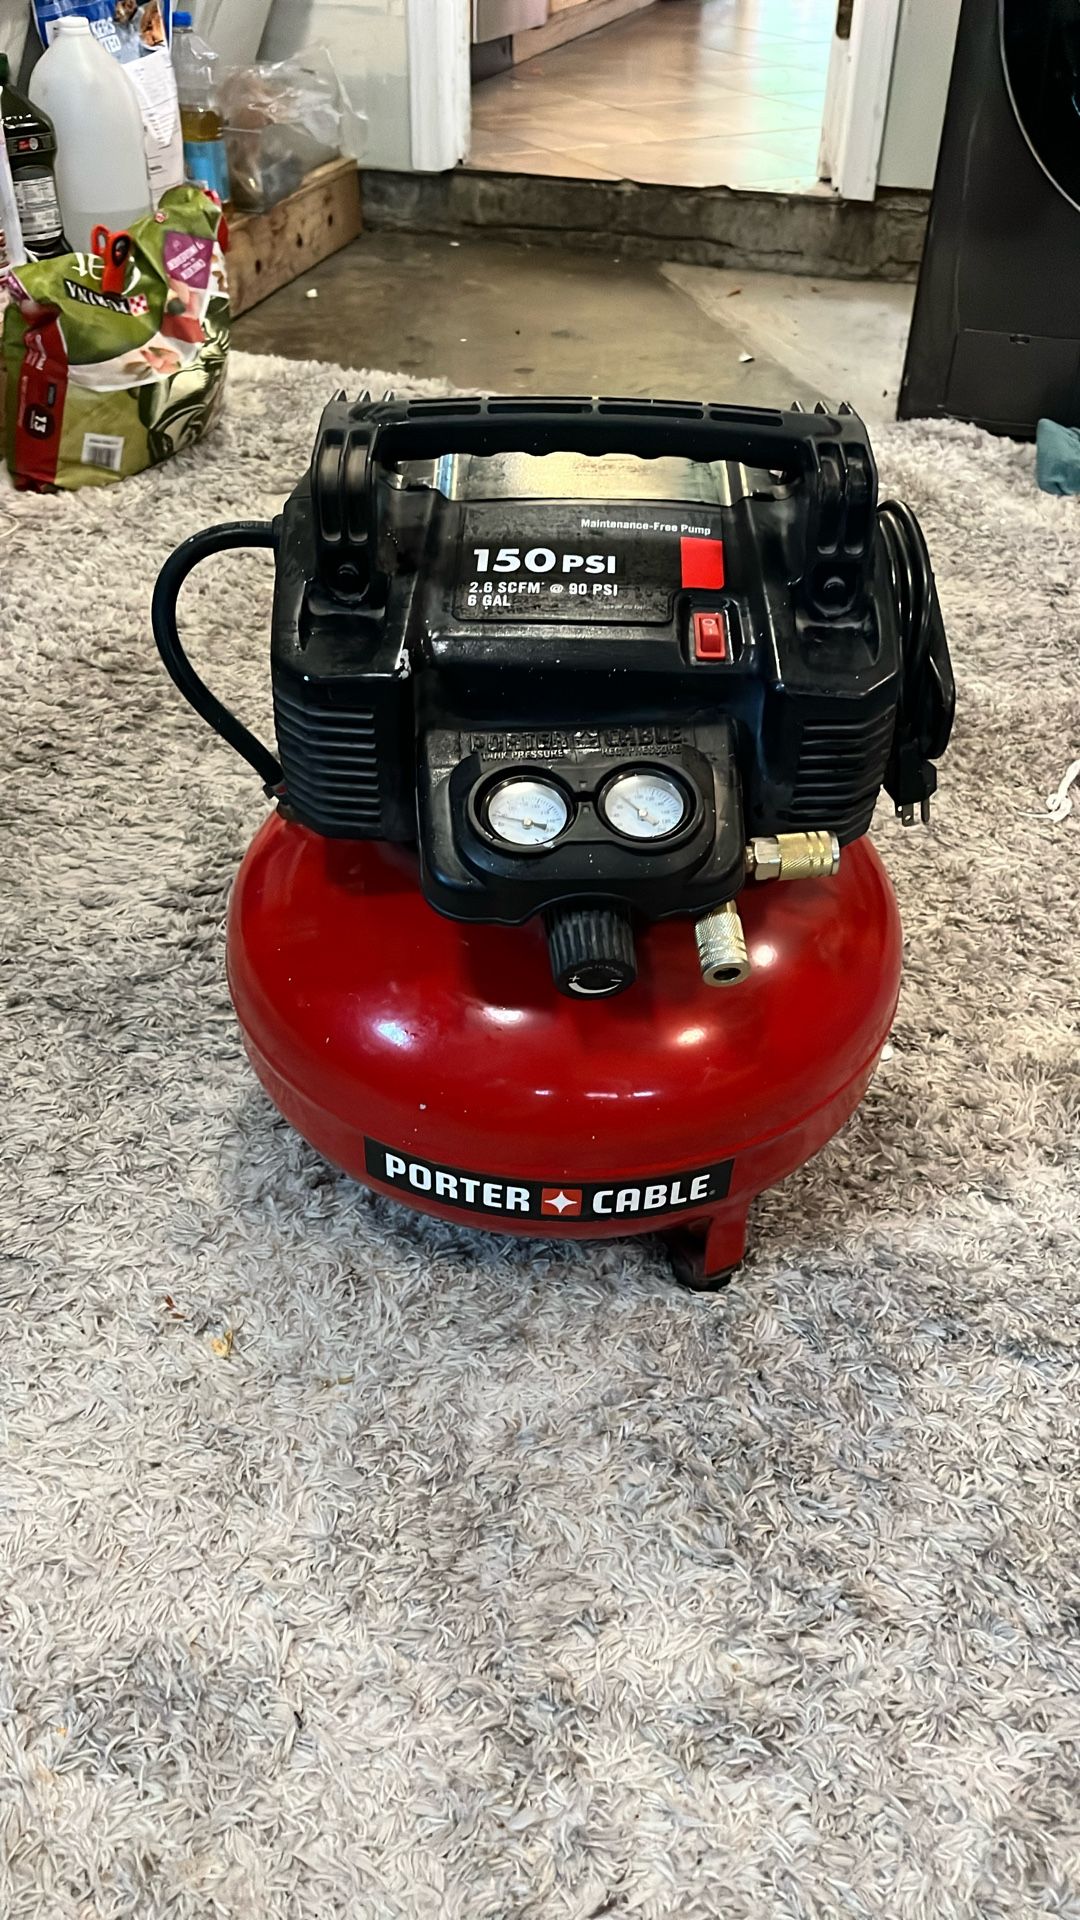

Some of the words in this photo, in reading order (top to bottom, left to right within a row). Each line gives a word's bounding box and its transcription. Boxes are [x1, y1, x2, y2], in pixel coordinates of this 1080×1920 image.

[581, 518, 678, 533] Maintenance-Free
[681, 524, 711, 536] Pump
[474, 547, 556, 573] 150
[562, 554, 616, 574] PSI
[469, 581, 493, 594] 2.6
[550, 583, 564, 594] @
[569, 583, 587, 595] 90
[593, 584, 618, 597] PSI
[467, 595, 477, 606] 6
[482, 595, 511, 607] GAL
[512, 749, 564, 759] PRESSURE
[385, 1153, 530, 1211] PORTER
[593, 1174, 710, 1213] CABLE
